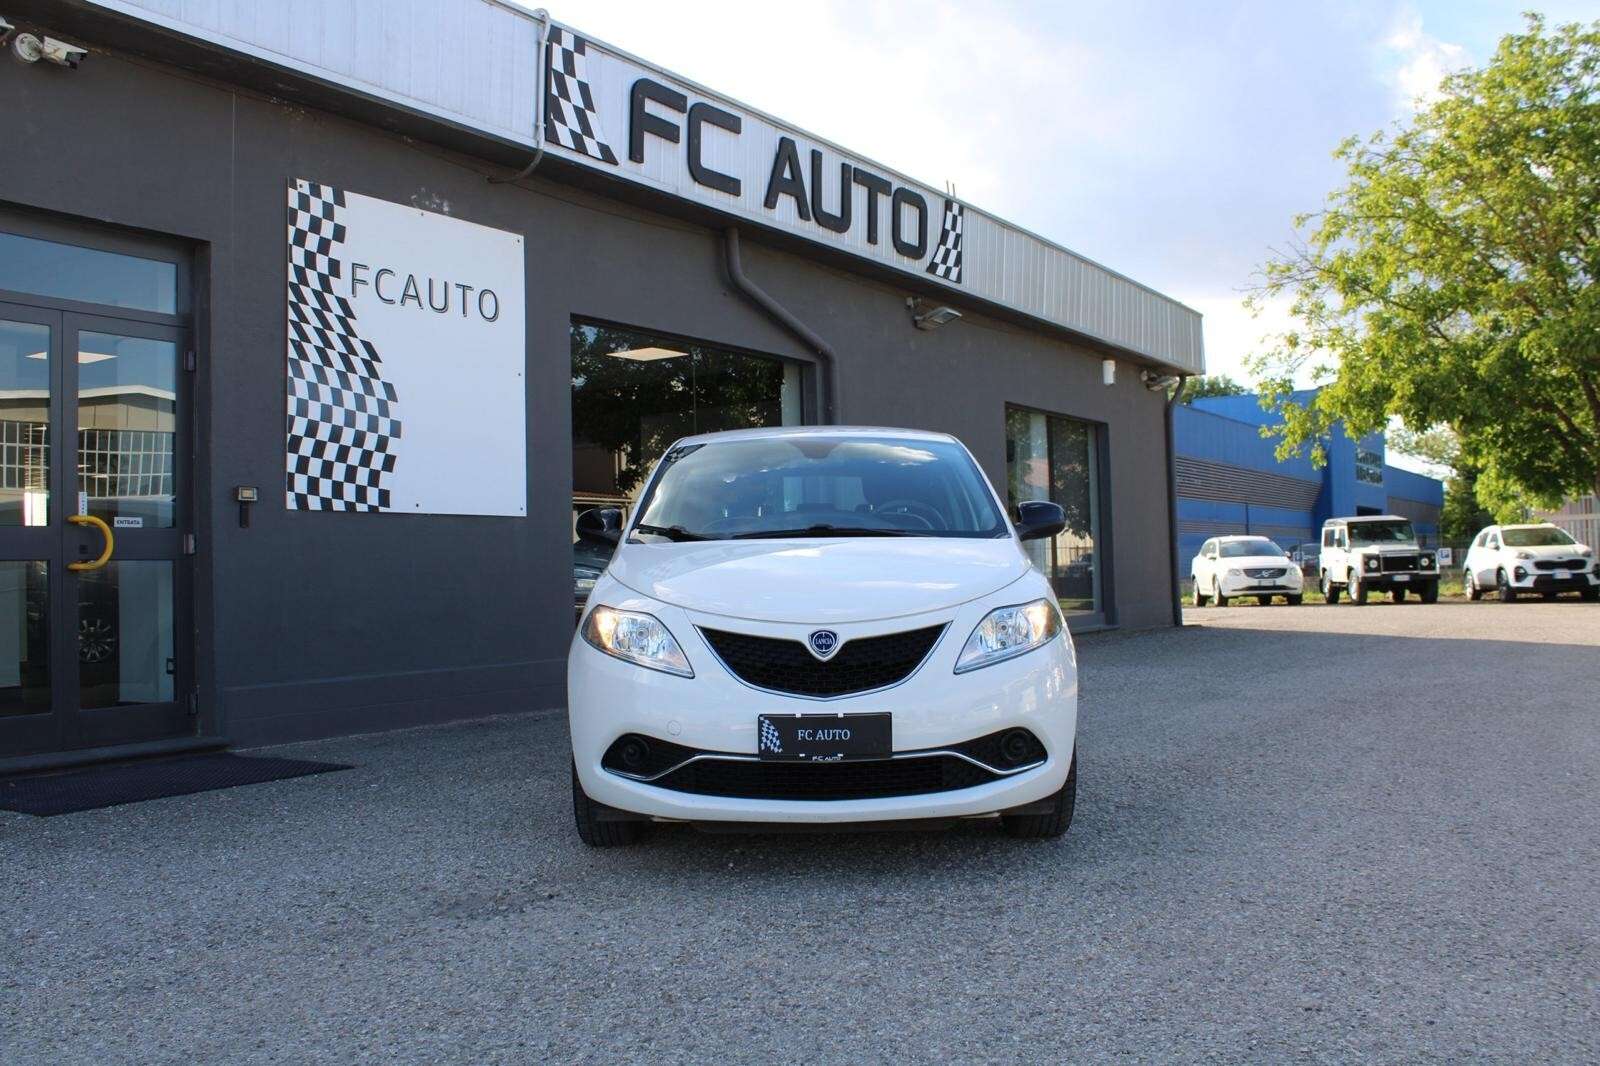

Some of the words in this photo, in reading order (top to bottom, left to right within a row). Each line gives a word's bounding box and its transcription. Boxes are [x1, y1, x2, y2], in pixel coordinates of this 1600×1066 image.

[628, 77, 742, 197] FC
[763, 136, 928, 260] AUTO
[798, 729, 813, 741] FC
[815, 729, 851, 741] AUTO
